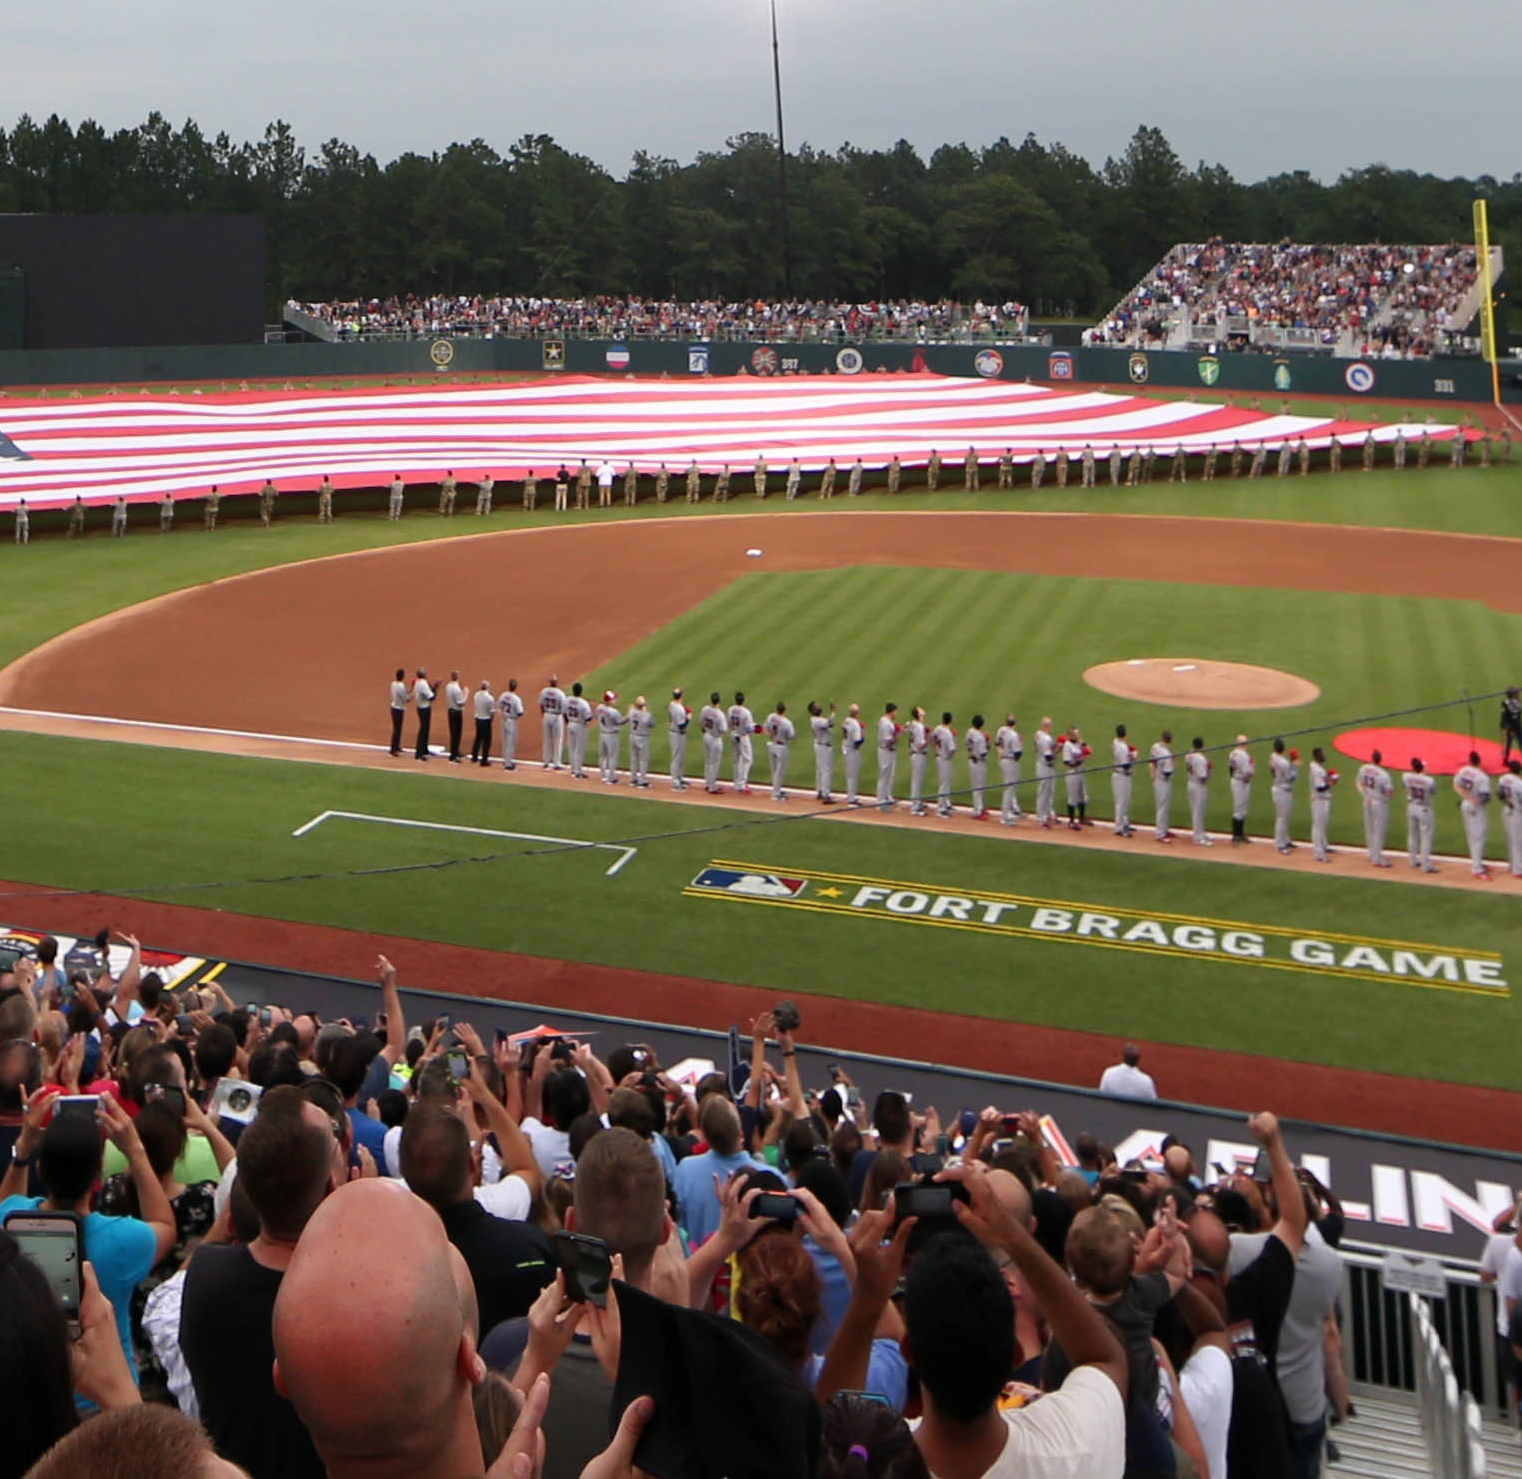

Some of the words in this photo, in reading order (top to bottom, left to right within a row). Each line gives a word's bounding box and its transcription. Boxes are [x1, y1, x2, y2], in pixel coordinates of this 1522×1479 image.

[850, 885, 1017, 925] FORT
[1029, 907, 1266, 958] BRAGG
[1289, 937, 1509, 988] GAME
